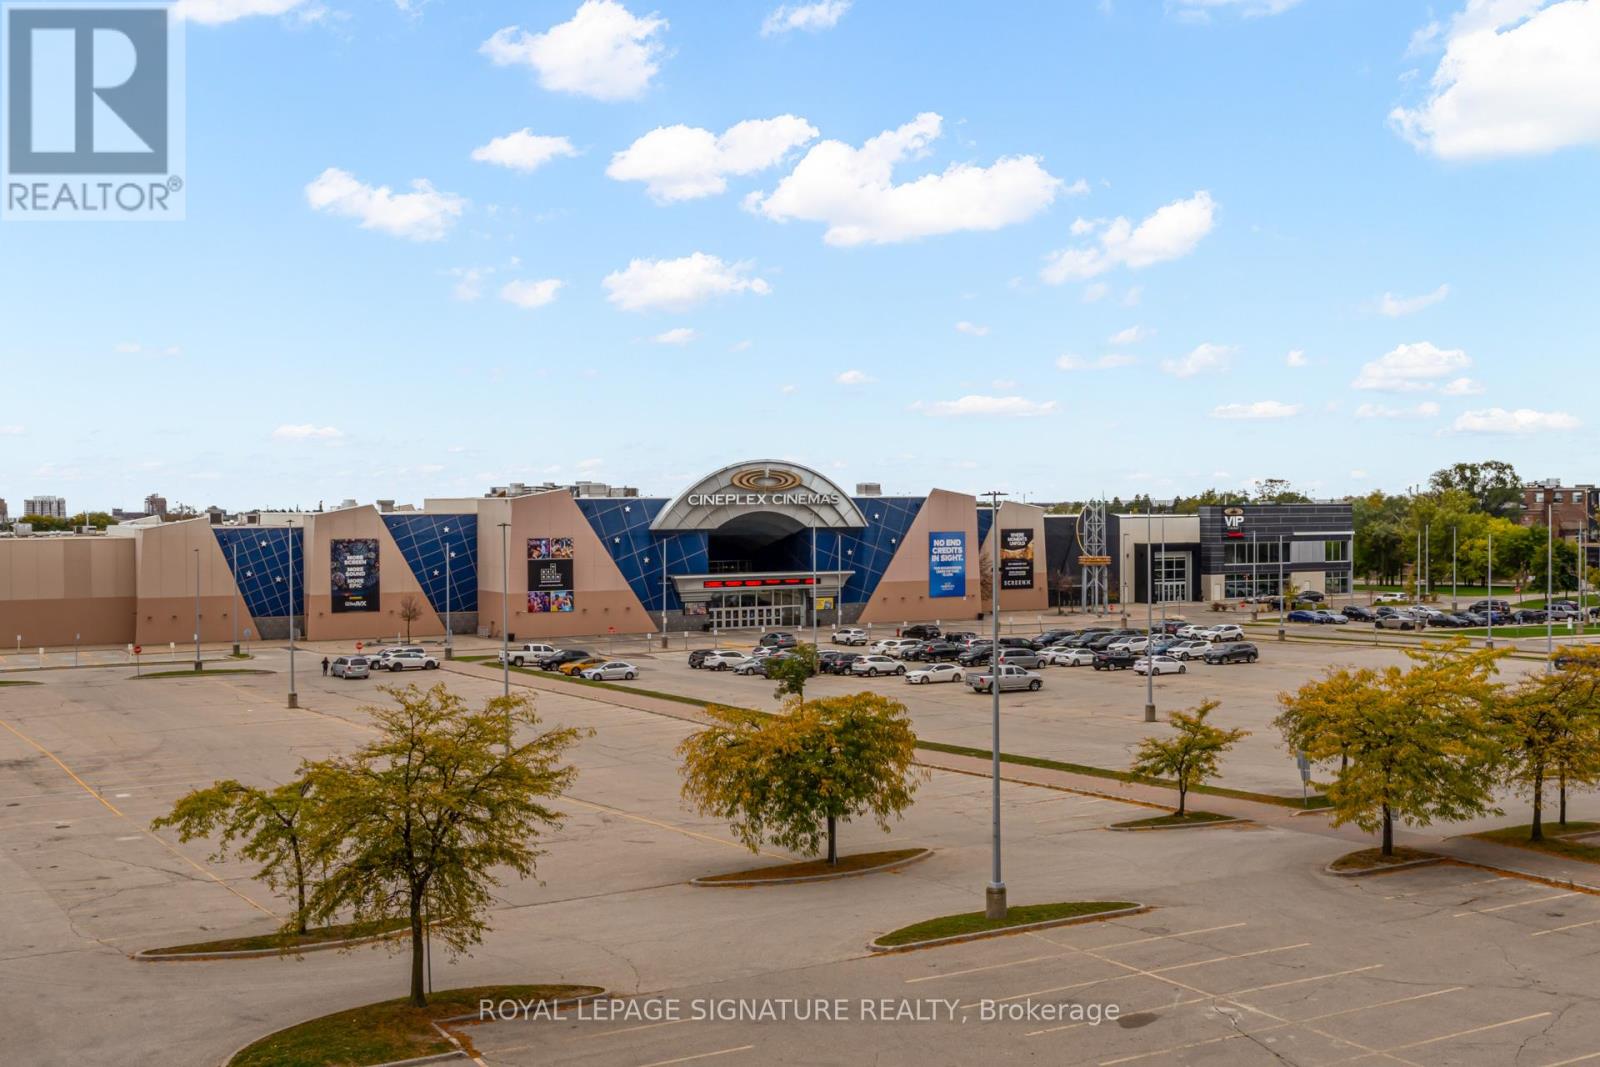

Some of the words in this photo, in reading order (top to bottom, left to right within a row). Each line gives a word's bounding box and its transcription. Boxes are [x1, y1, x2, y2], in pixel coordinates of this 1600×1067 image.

[688, 494, 767, 506] CINEPLEX
[772, 494, 840, 505] CINEMAS
[1224, 516, 1244, 526] VIP
